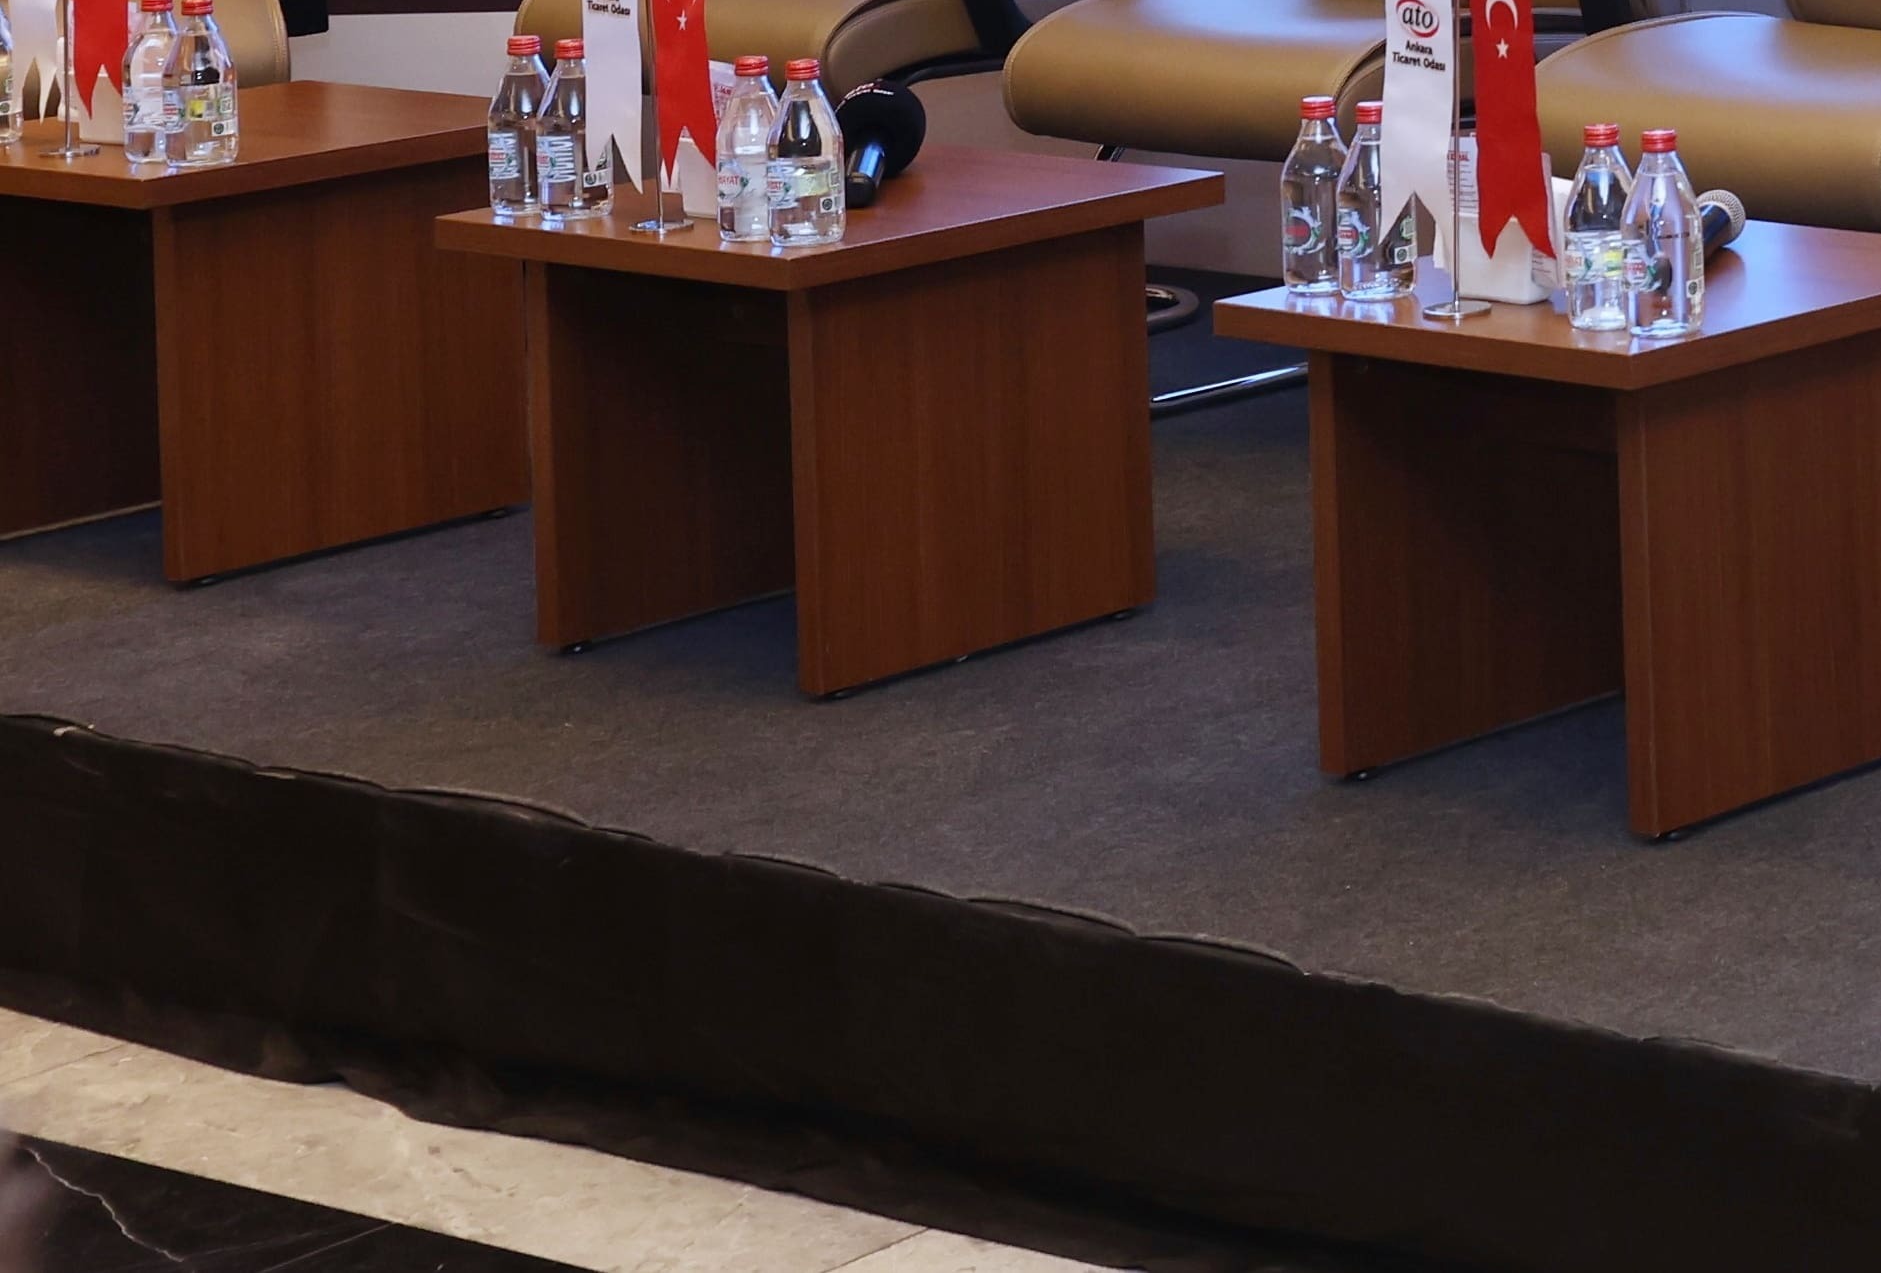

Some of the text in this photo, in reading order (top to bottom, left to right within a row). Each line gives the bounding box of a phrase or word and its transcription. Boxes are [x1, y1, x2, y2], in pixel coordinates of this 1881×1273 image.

[1402, 6, 1434, 29] ato
[1405, 40, 1433, 54] Ankara
[1392, 52, 1421, 66] Ticaret
